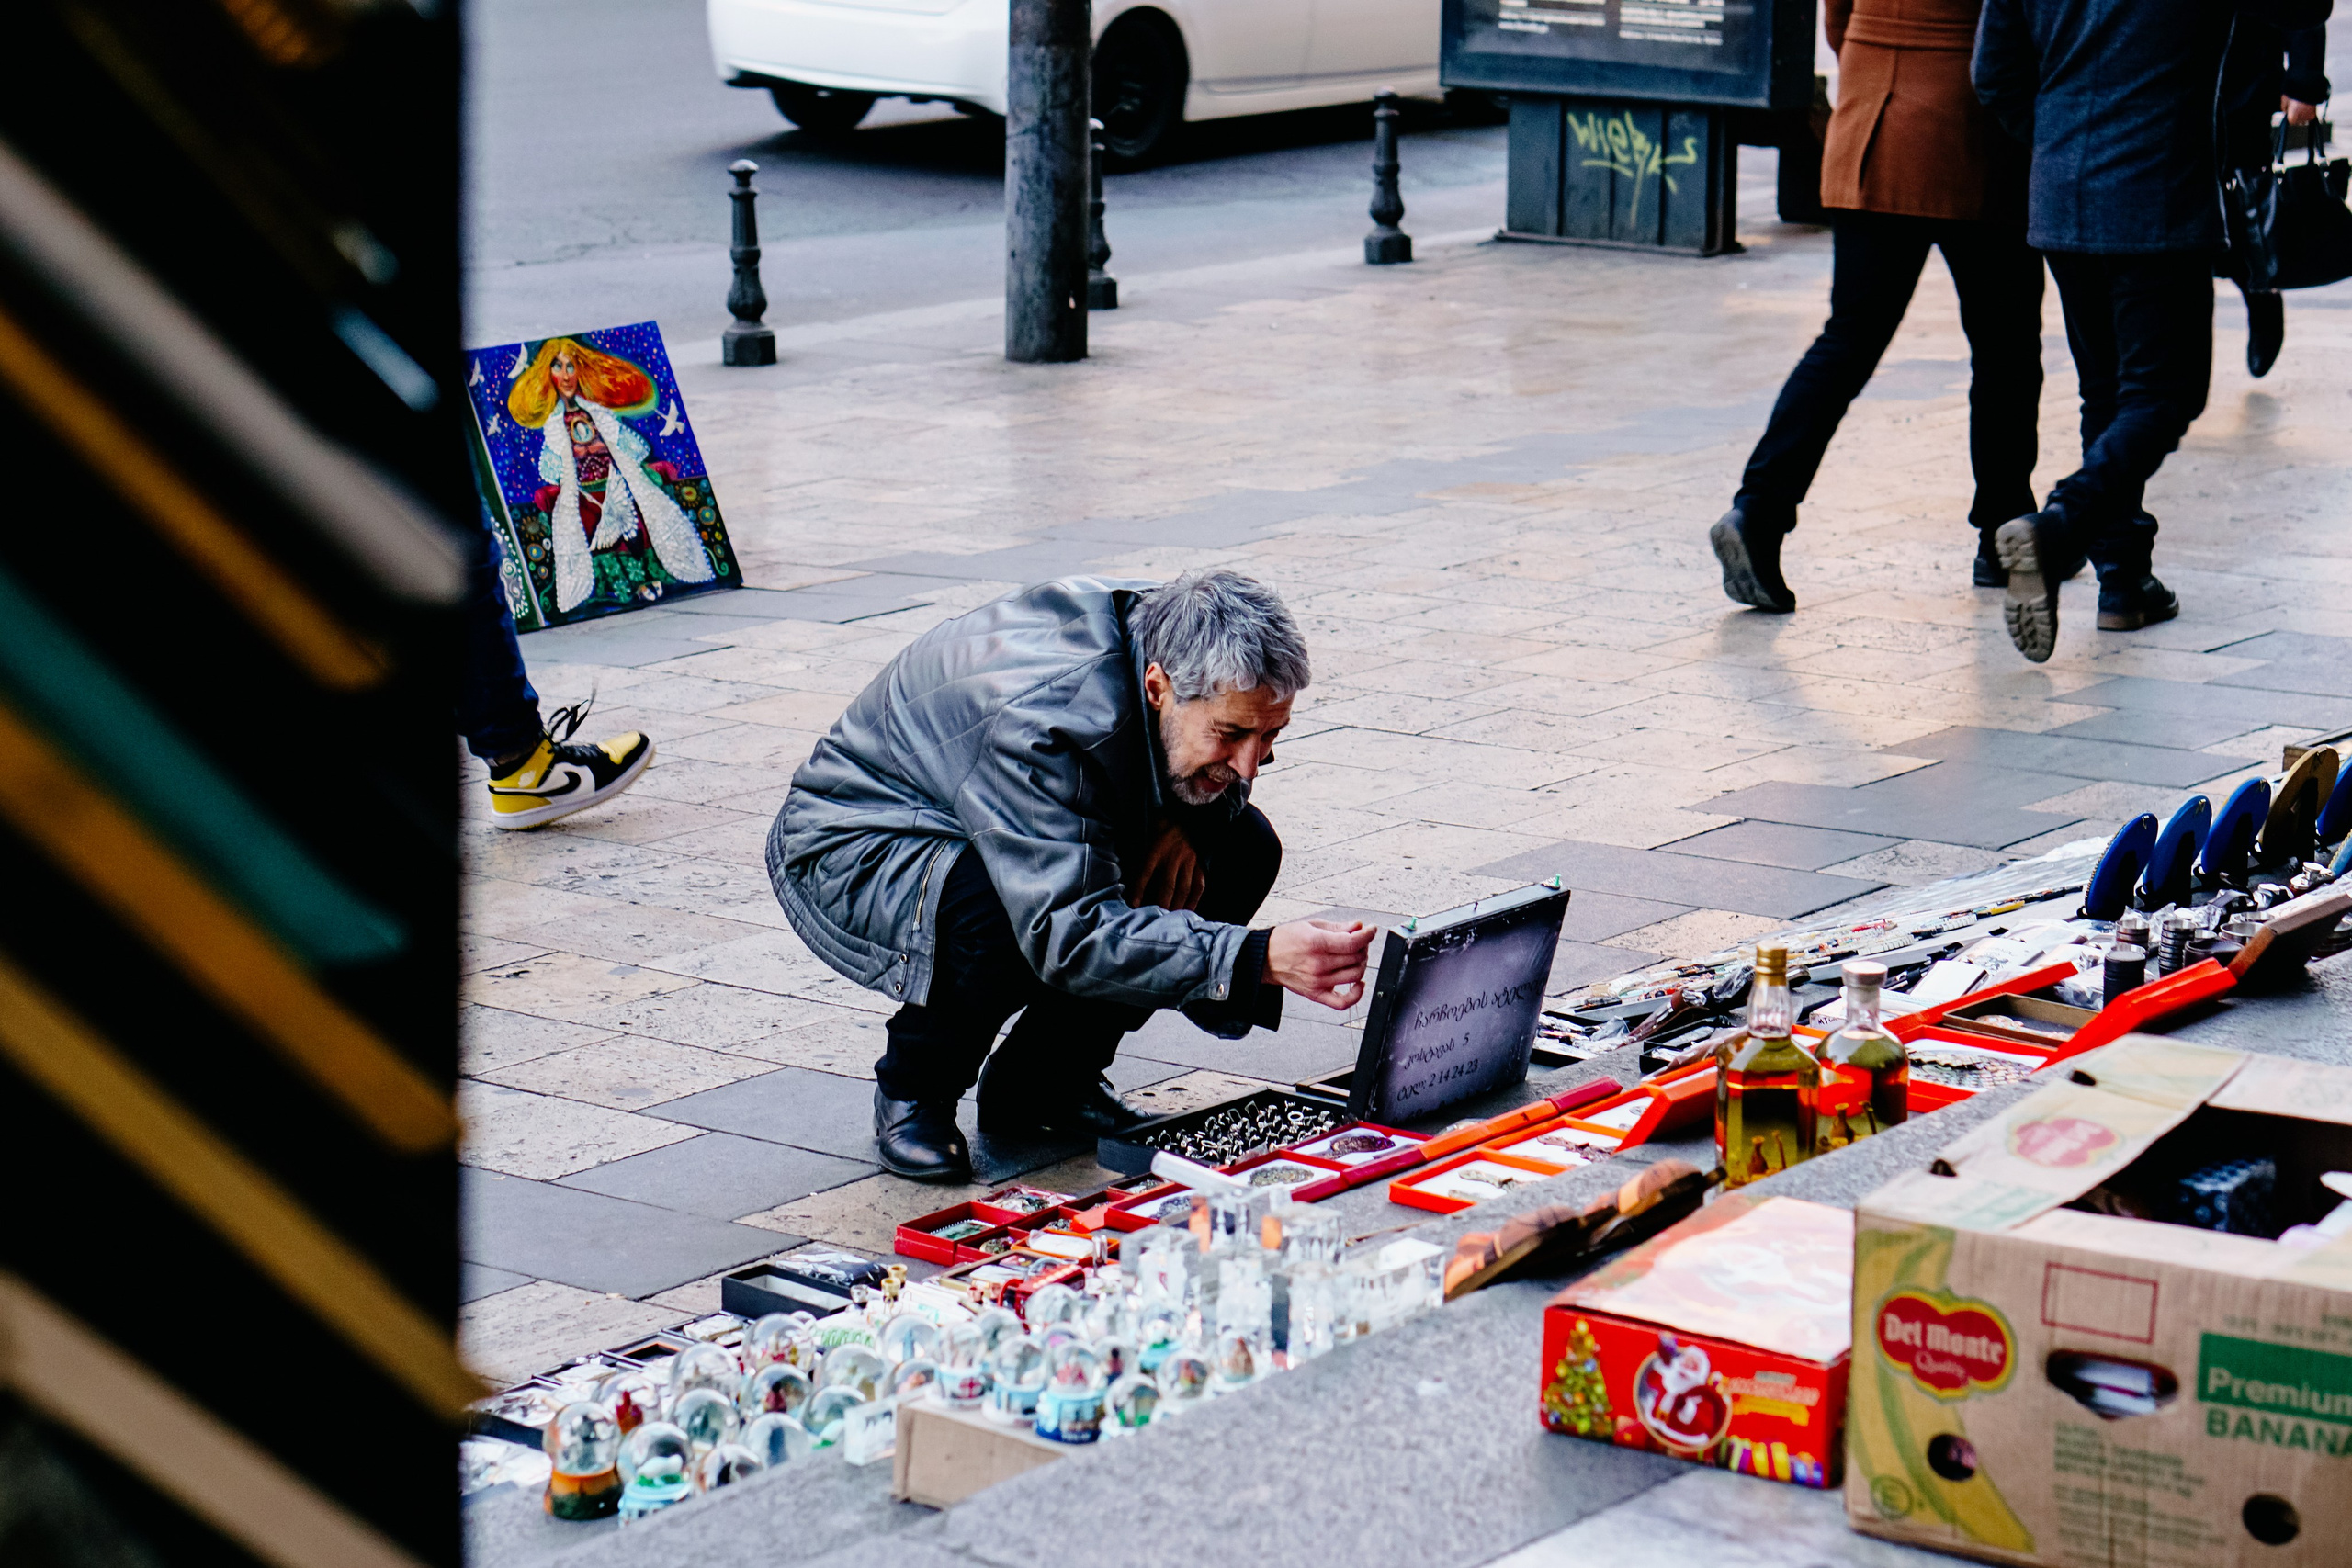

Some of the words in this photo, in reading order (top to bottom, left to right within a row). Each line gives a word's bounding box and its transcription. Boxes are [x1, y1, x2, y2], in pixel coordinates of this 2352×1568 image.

[1463, 1032, 1470, 1047] 5
[1885, 1313, 1922, 1348] Del
[1926, 1323, 2004, 1366] Monte
